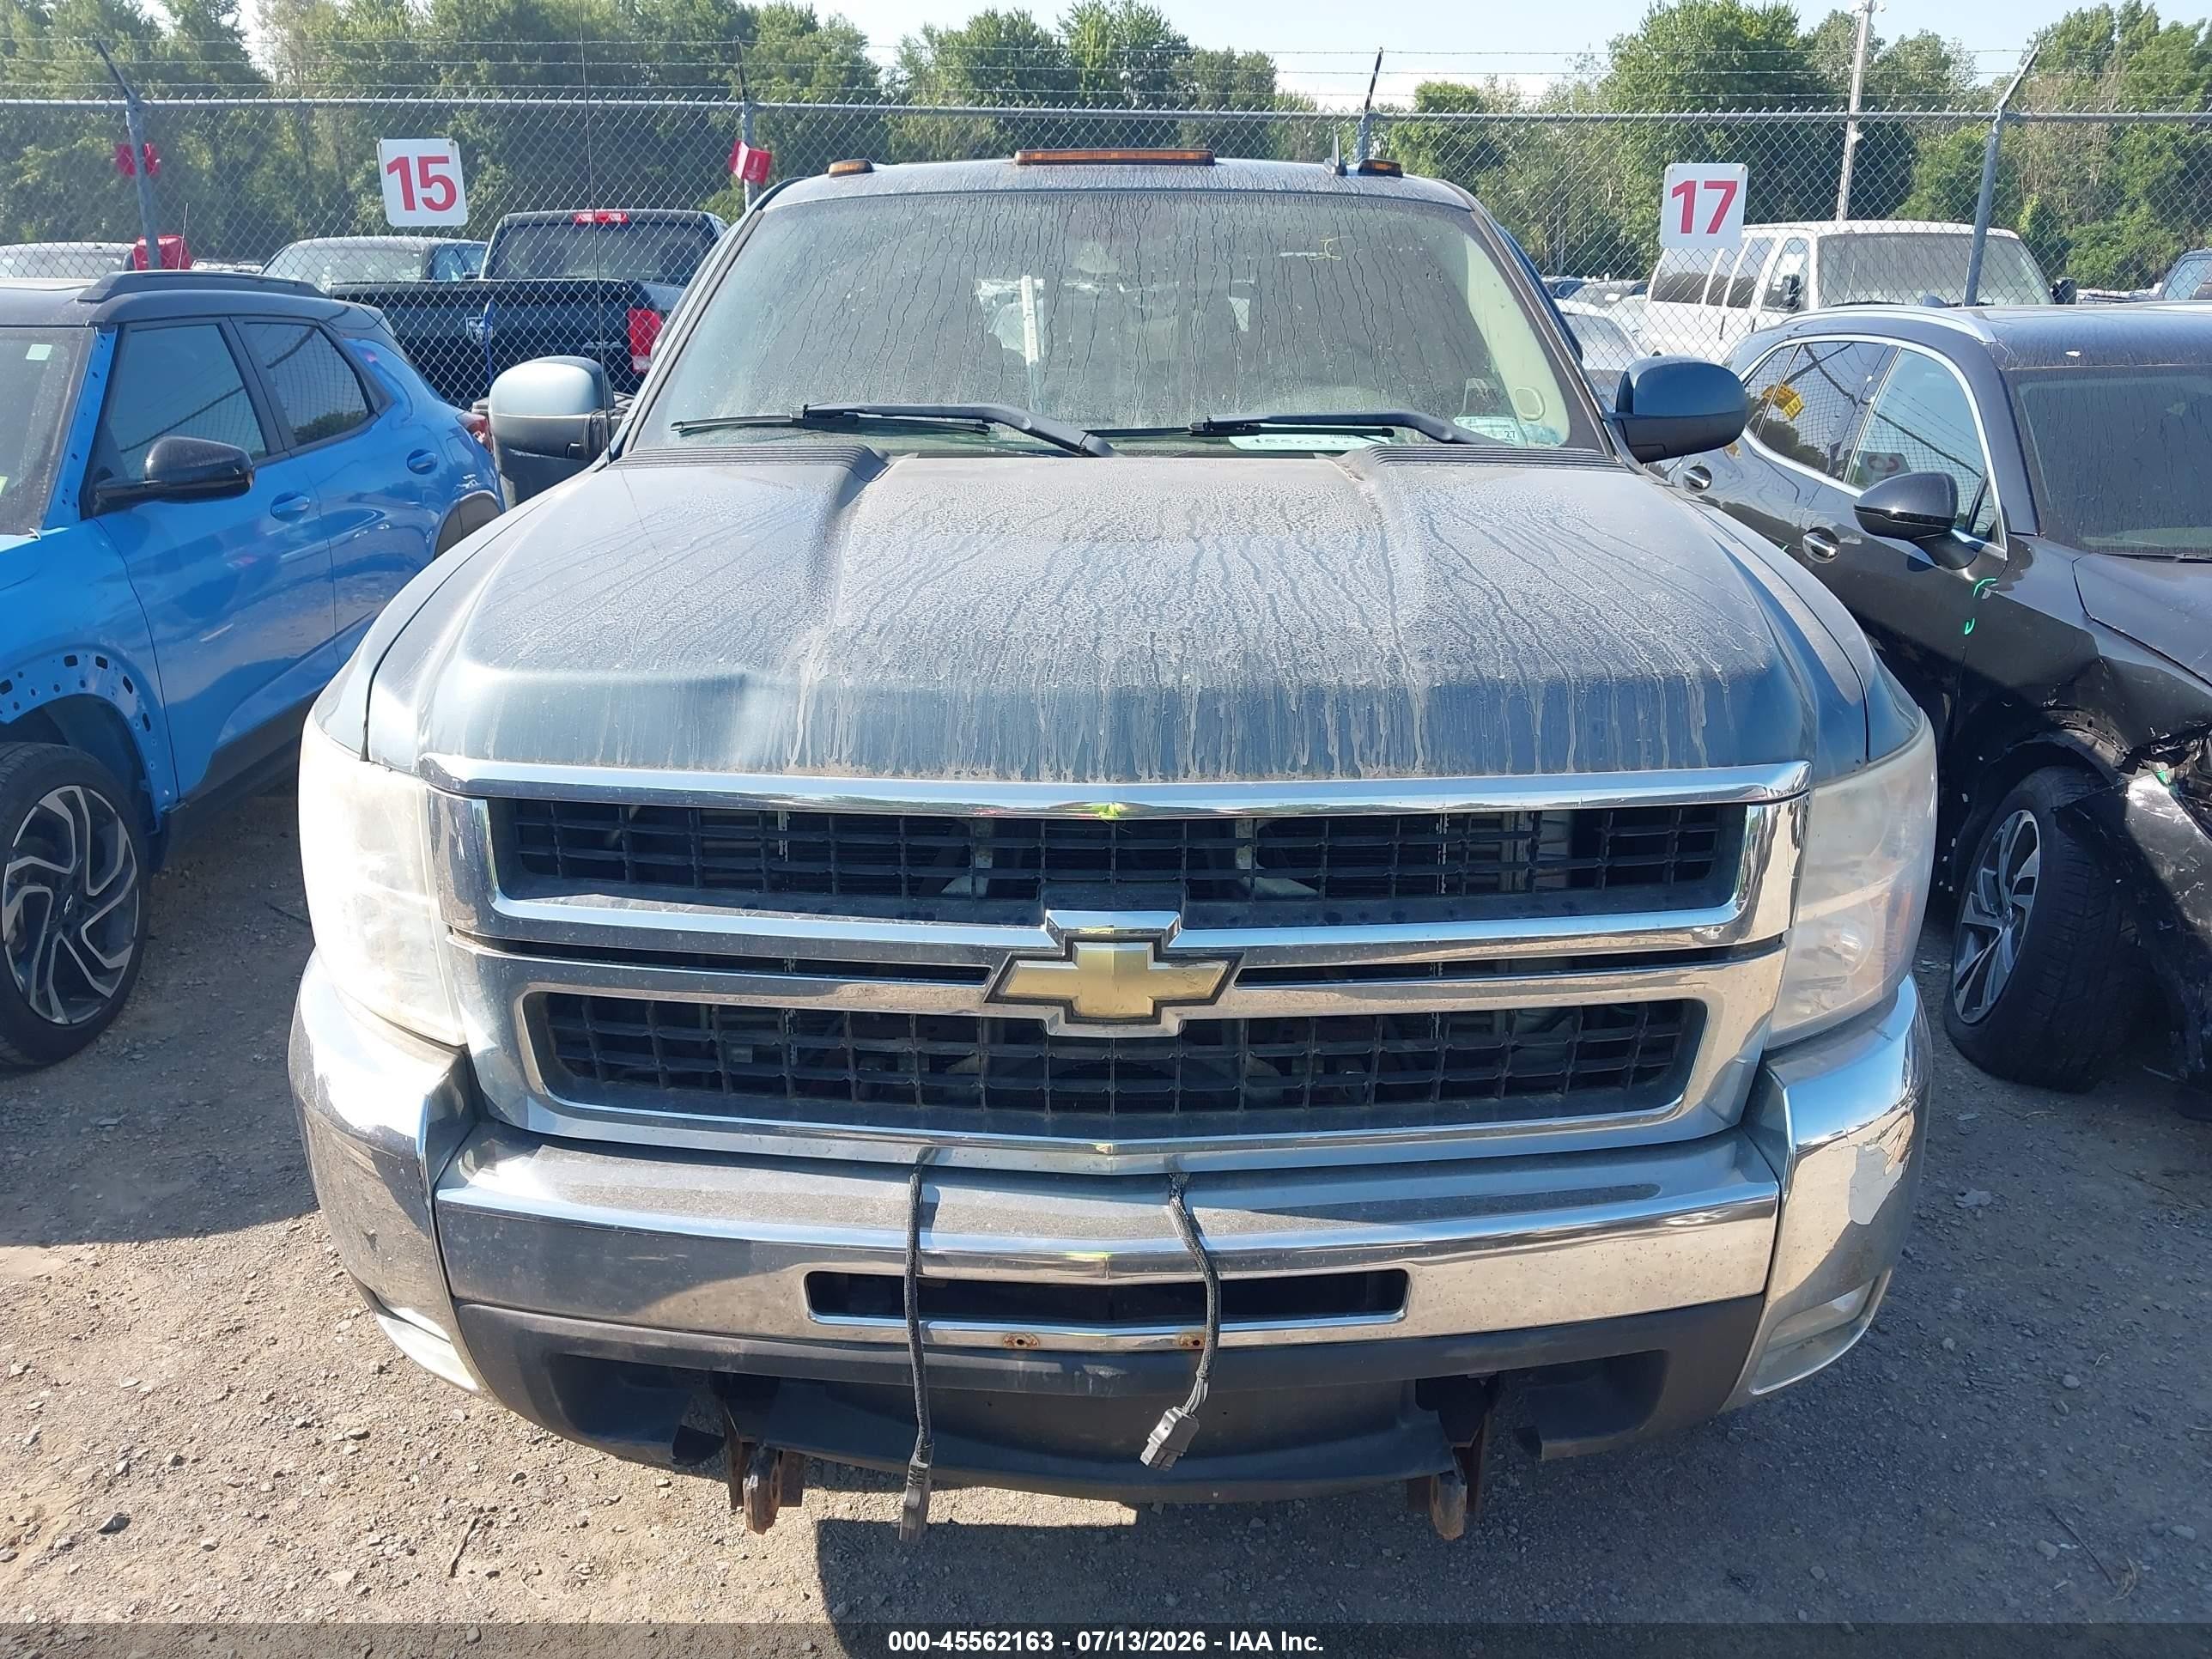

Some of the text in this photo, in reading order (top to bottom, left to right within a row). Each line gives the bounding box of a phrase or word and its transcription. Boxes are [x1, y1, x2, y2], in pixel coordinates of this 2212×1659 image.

[386, 155, 457, 211] 15
[1672, 180, 1738, 234] 17
[1504, 430, 1516, 439] 27
